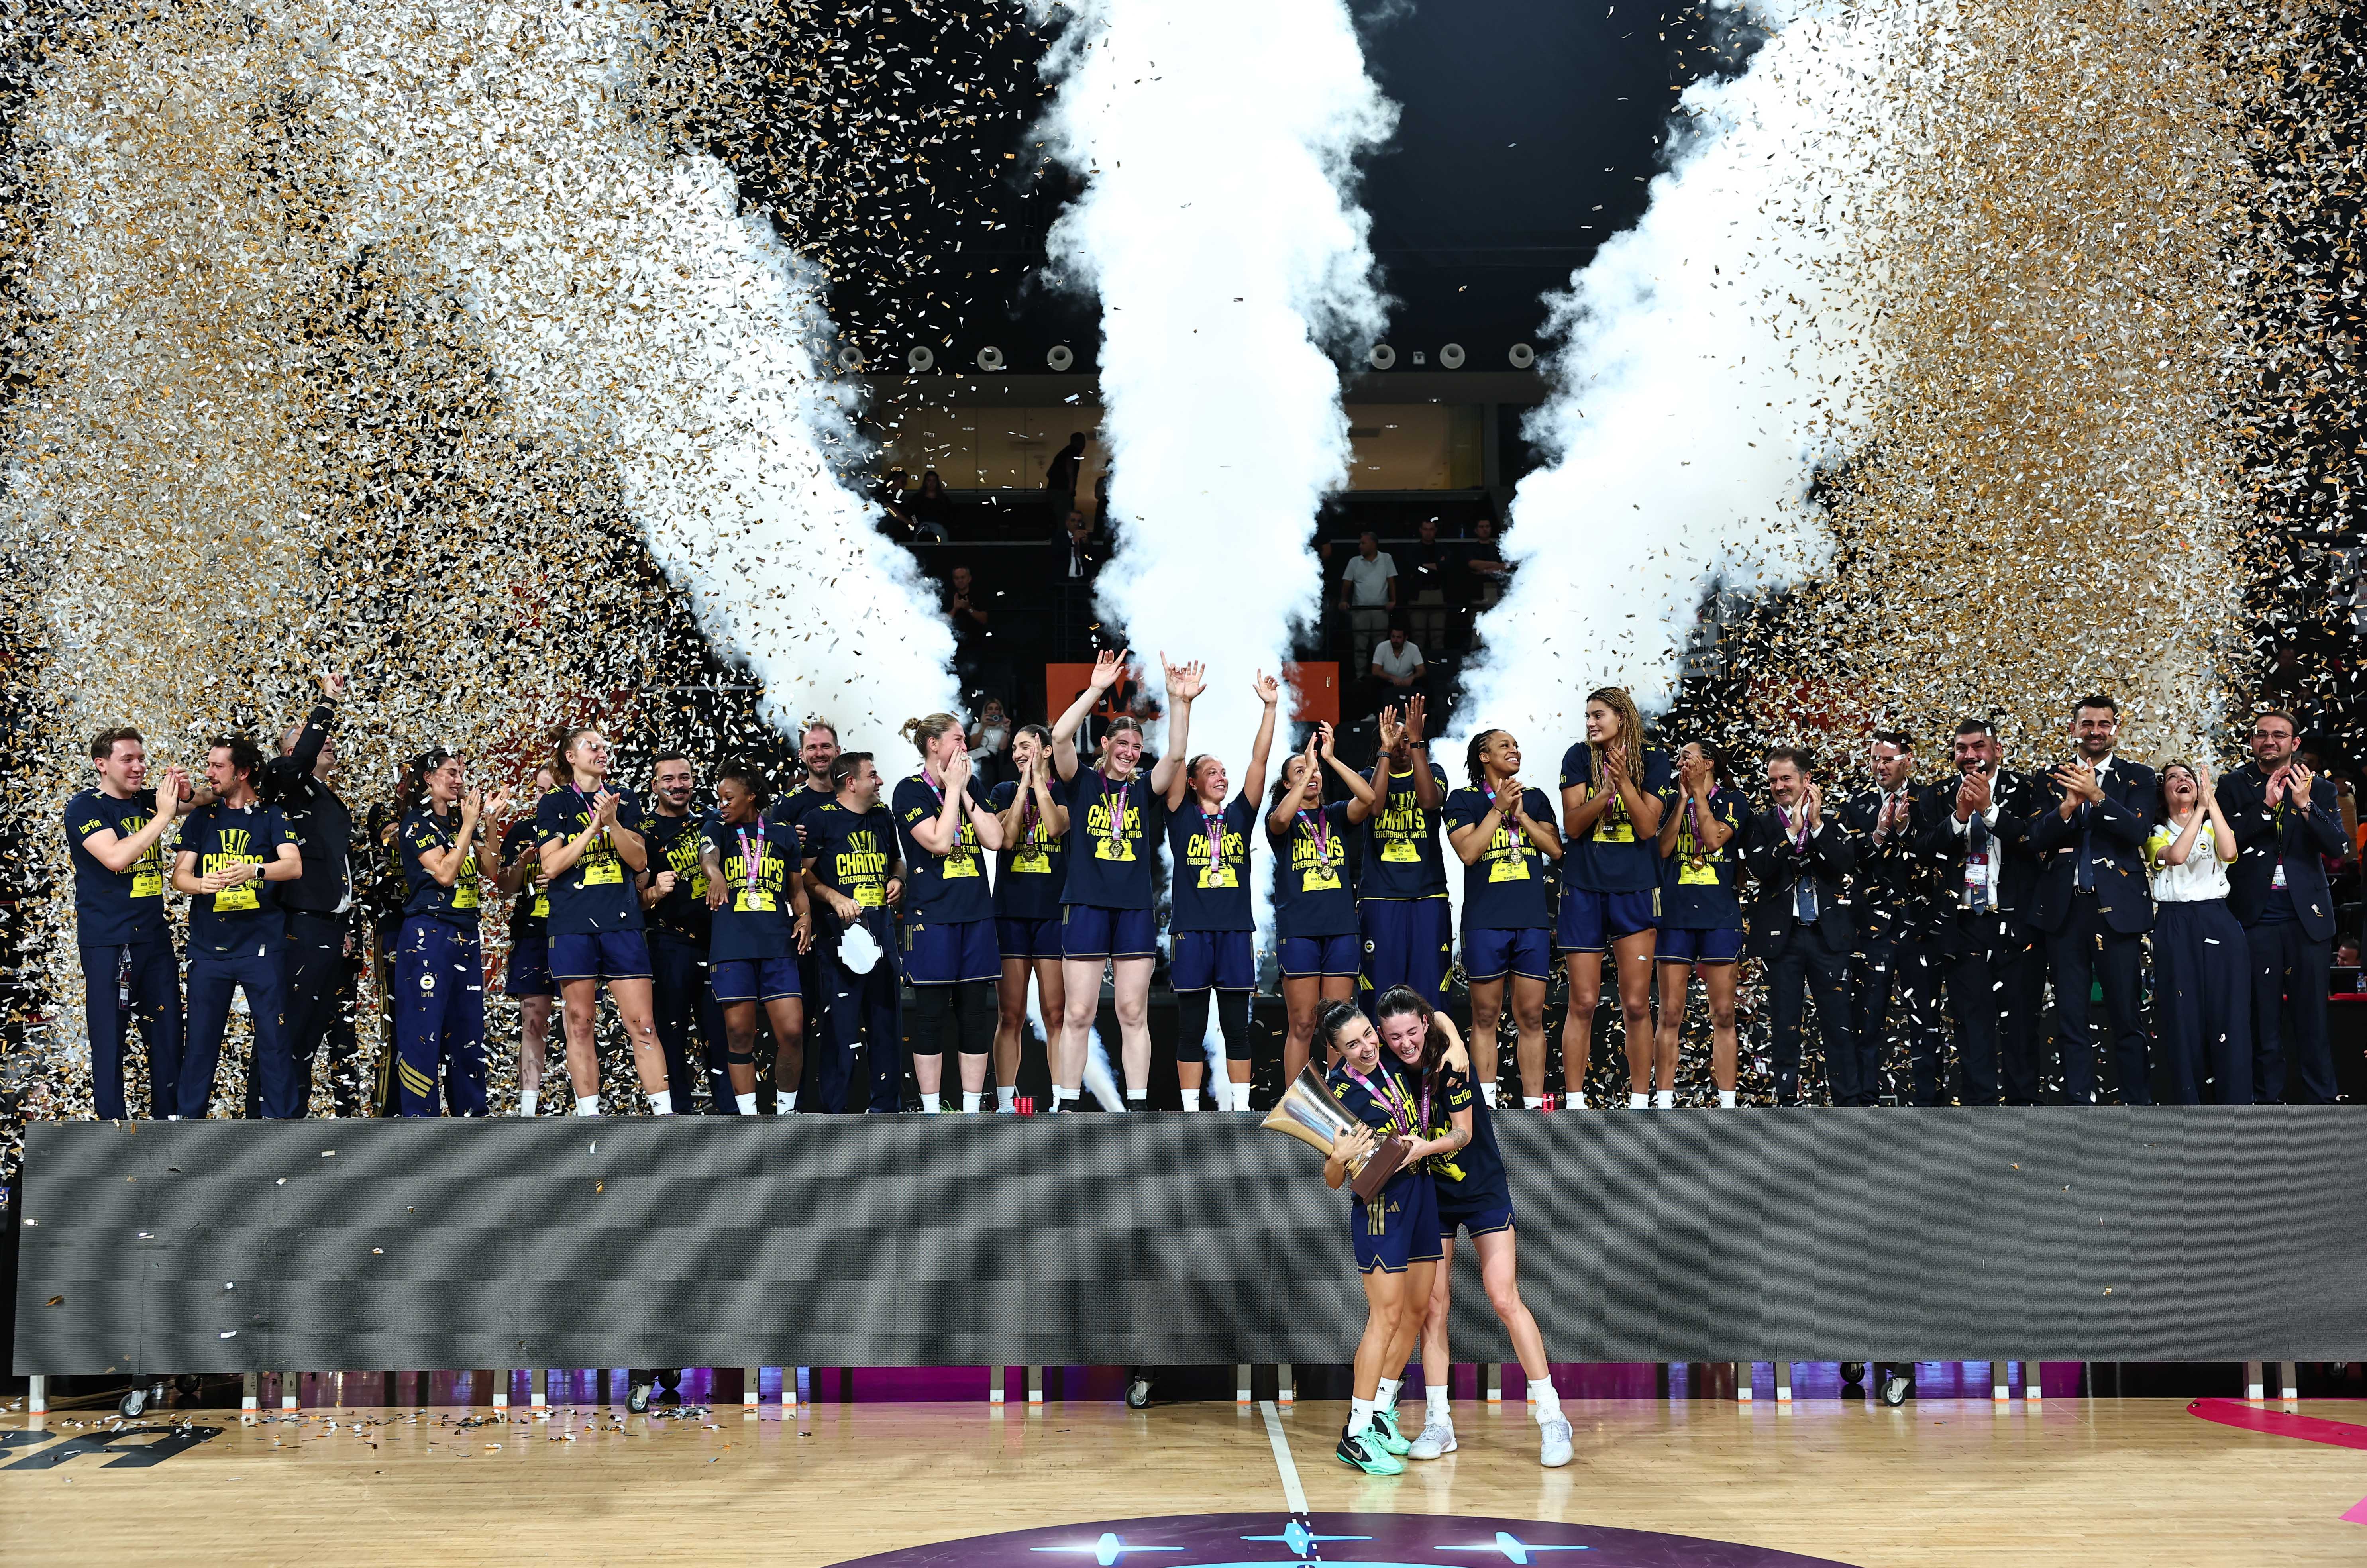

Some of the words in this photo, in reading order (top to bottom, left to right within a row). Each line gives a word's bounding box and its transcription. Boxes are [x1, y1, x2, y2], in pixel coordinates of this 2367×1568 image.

[1658, 785, 1667, 800] tar
[905, 807, 923, 822] tarfin
[1374, 807, 1425, 830] CHAMS
[79, 819, 102, 835] tarfin
[1446, 818, 1457, 832] arfin
[173, 834, 183, 844] fin
[285, 830, 299, 841] tar
[226, 843, 236, 854] 3x
[861, 843, 869, 854] 3x
[666, 843, 702, 873] CHA
[836, 852, 888, 877] CHAMP
[838, 874, 876, 885] FENERBAHÇE
[1333, 1082, 1351, 1100] arfin
[1450, 1088, 1472, 1105] tarfin
